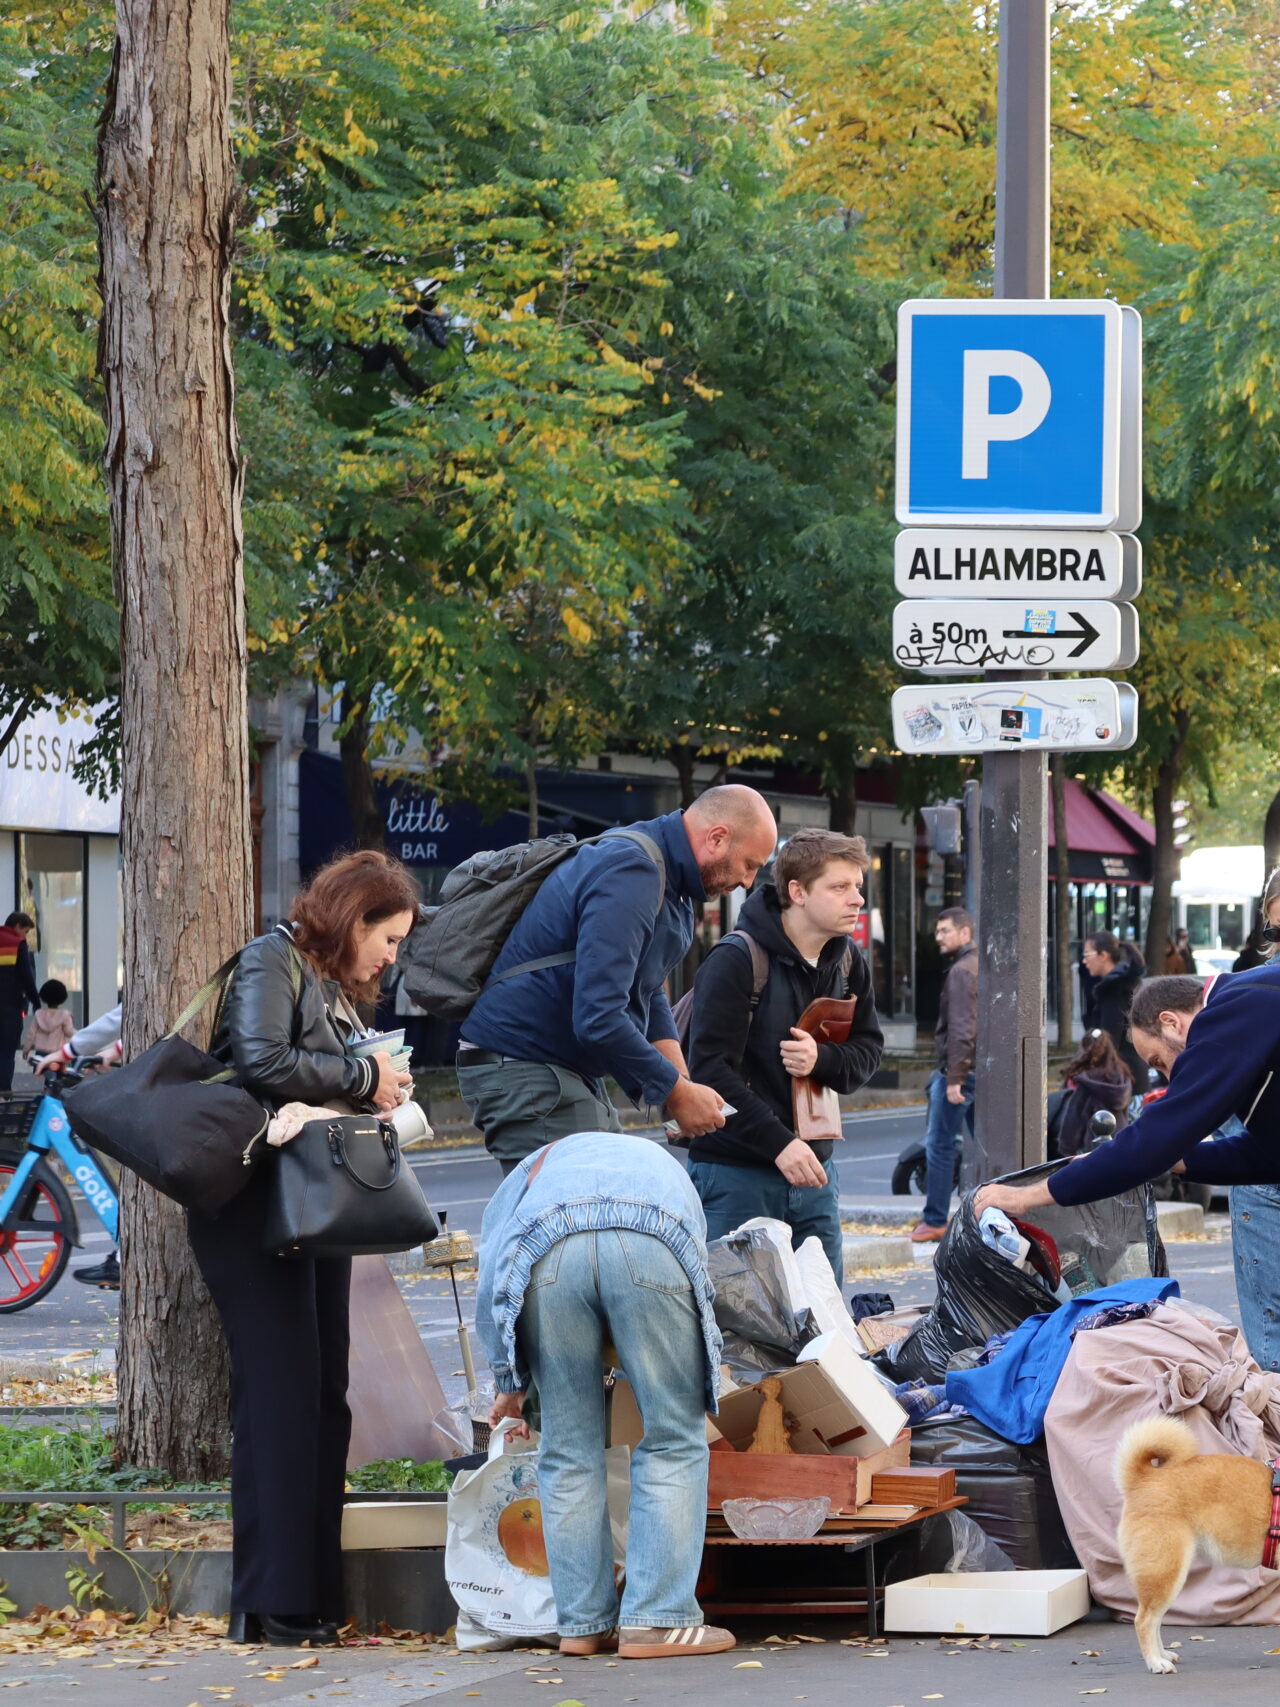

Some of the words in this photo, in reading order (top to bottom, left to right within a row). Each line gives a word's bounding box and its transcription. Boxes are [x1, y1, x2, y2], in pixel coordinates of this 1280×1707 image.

[962, 350, 1052, 480] P
[908, 547, 1106, 581] ALHAMBRA
[909, 622, 923, 645] à
[932, 622, 988, 645] 50m
[7, 734, 111, 777] DESSA
[387, 797, 449, 832] little
[402, 843, 438, 859] BAR
[75, 1166, 114, 1215] dott
